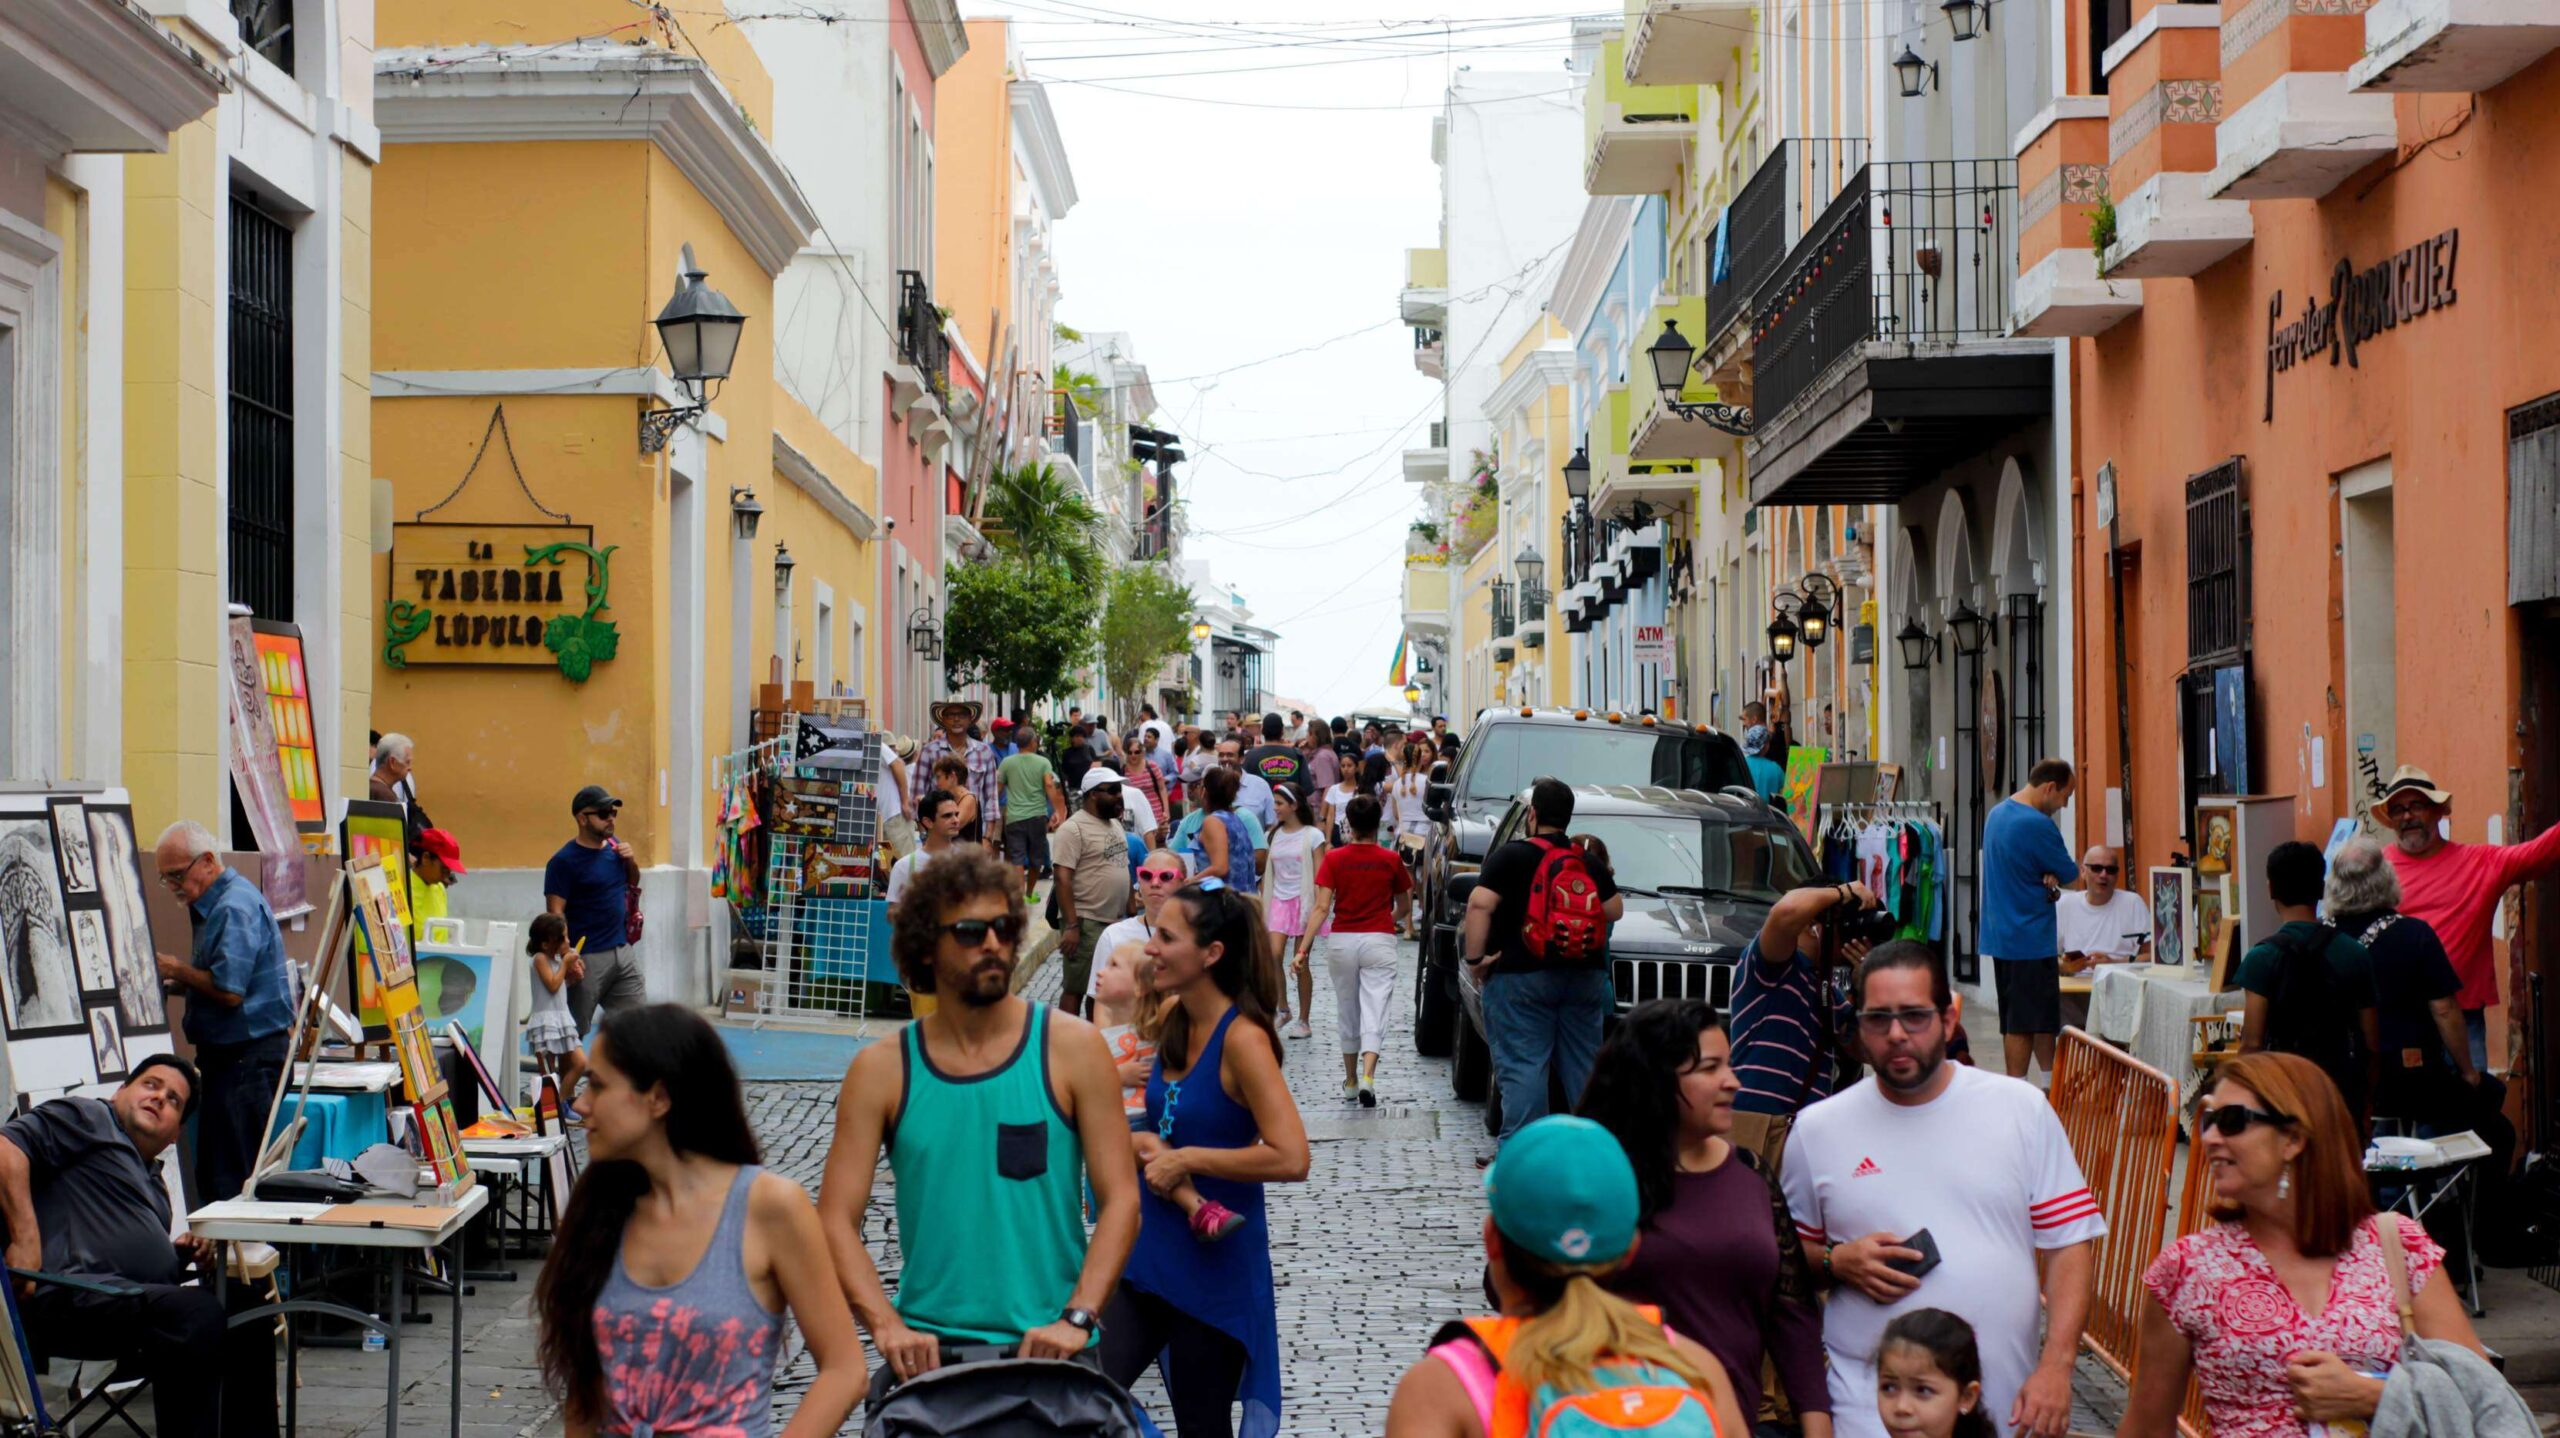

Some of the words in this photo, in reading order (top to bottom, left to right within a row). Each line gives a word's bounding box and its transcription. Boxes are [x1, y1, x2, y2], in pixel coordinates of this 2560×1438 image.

[468, 540, 493, 560] LA
[415, 568, 563, 602] TABERNA
[1637, 626, 1664, 641] ATM
[1683, 944, 1712, 955] Jeep
